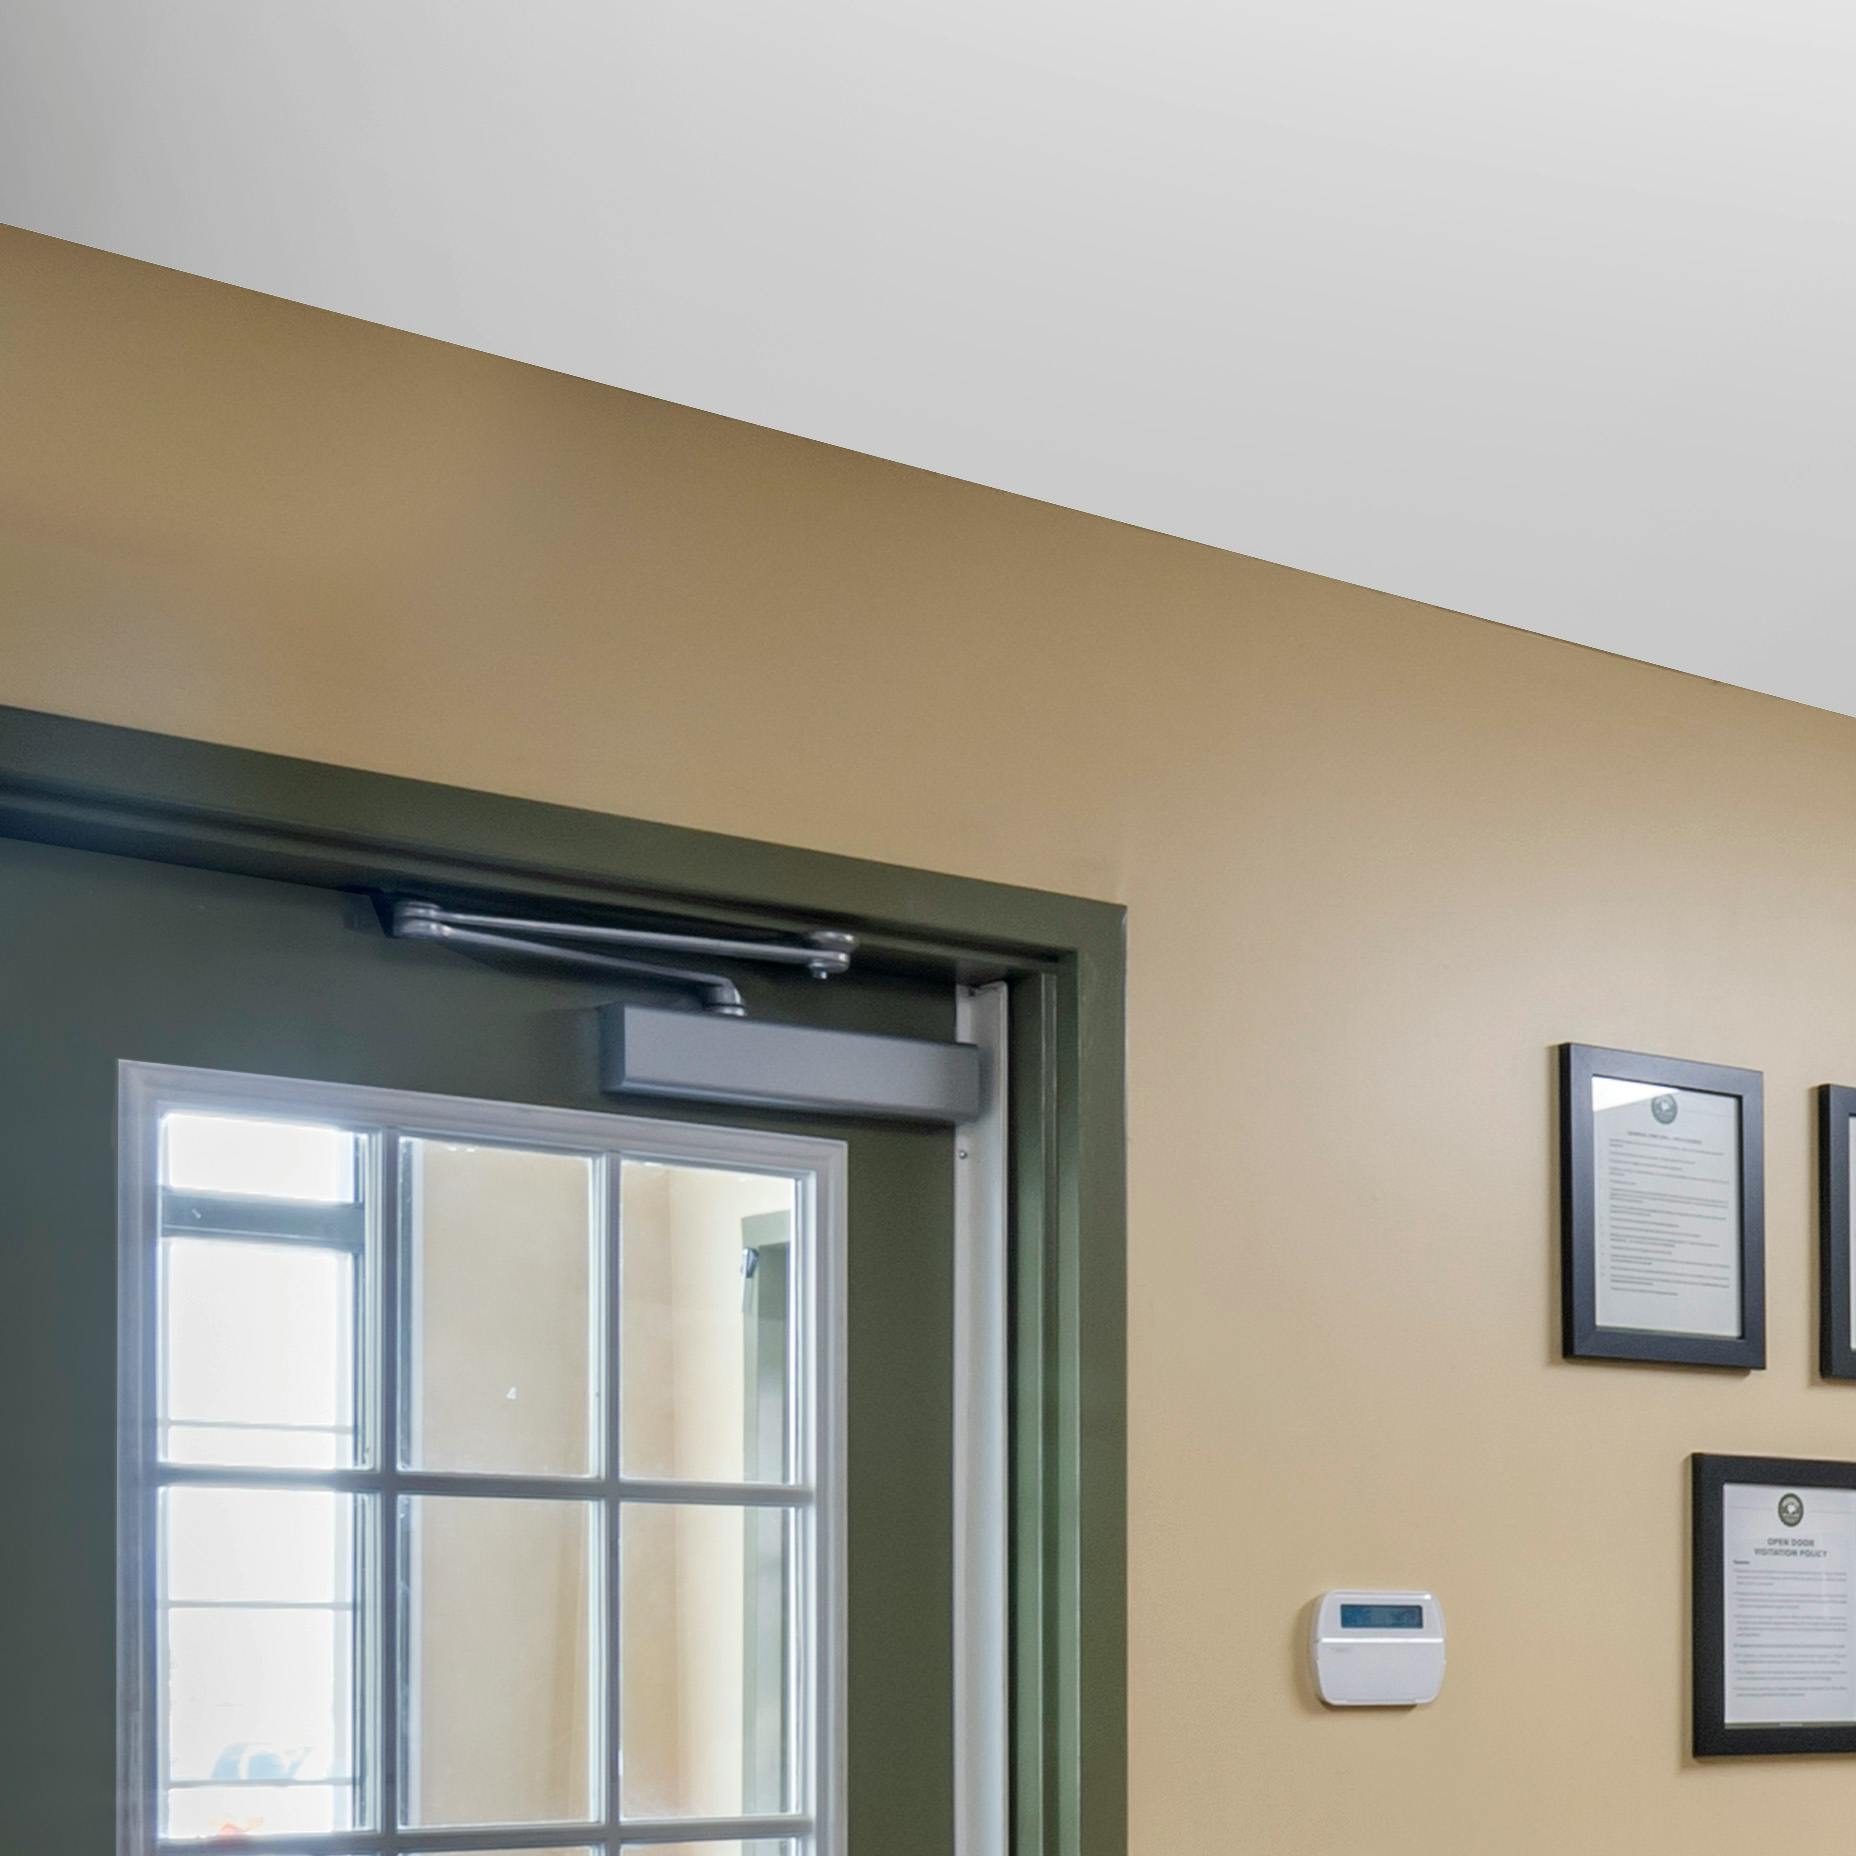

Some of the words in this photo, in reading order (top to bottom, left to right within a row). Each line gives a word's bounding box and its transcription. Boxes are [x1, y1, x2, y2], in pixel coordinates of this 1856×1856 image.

[1767, 1537, 1789, 1546] OPEN
[1791, 1538, 1815, 1547] DOOR
[1800, 1549, 1828, 1558] POLICY
